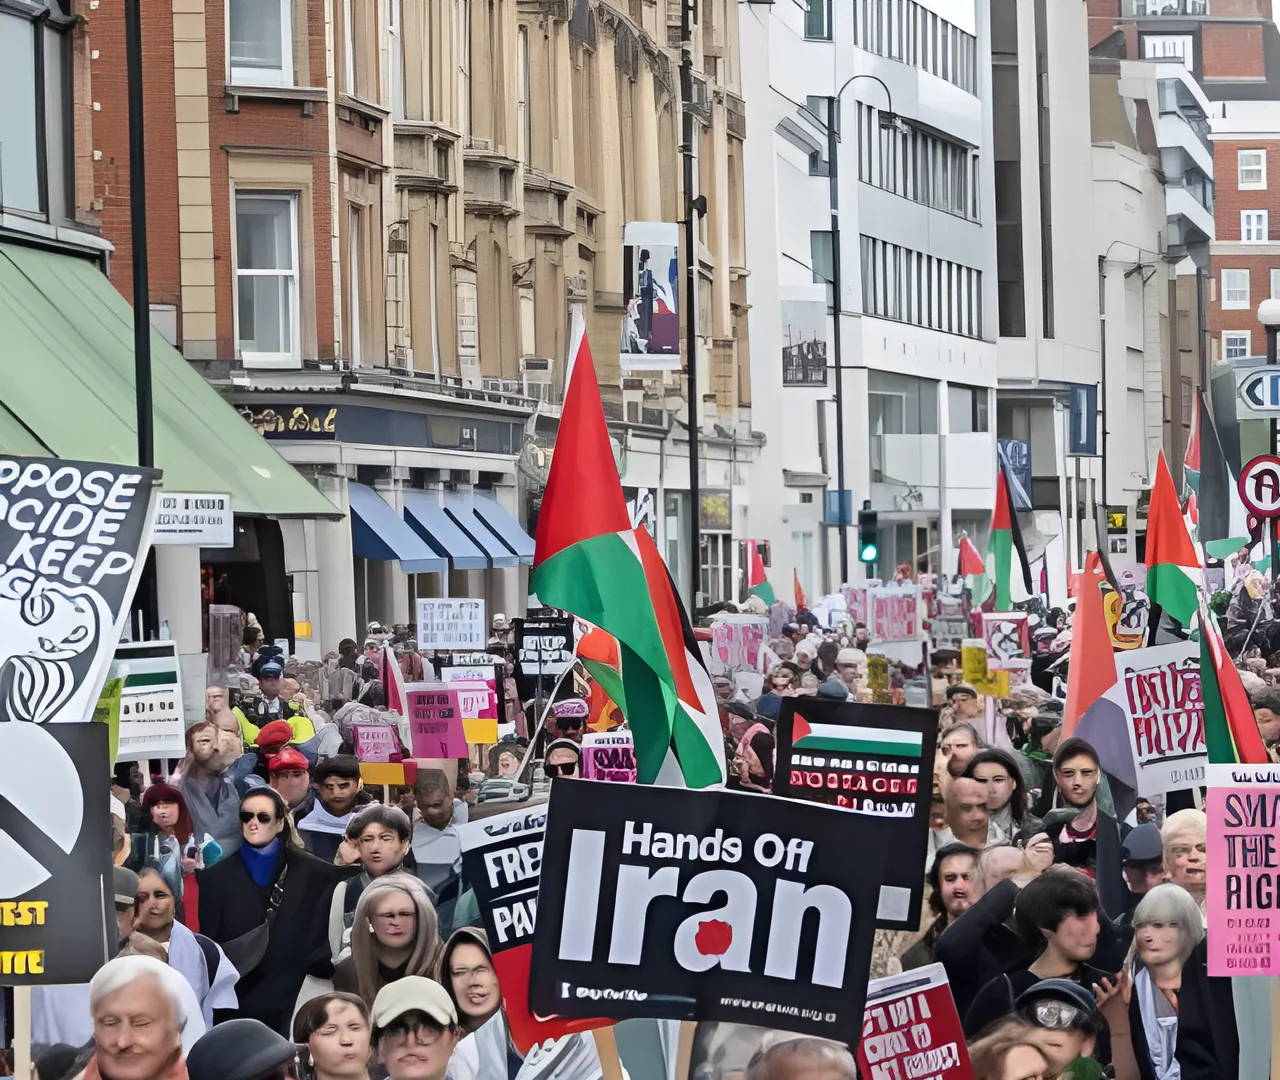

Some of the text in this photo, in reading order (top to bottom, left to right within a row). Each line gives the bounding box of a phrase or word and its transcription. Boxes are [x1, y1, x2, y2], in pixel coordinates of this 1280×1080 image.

[0, 494, 126, 545] CIDE
[6, 532, 134, 585] KEEP
[622, 820, 743, 863] Hands
[1224, 833, 1278, 868] THE
[558, 828, 852, 990] Iran
